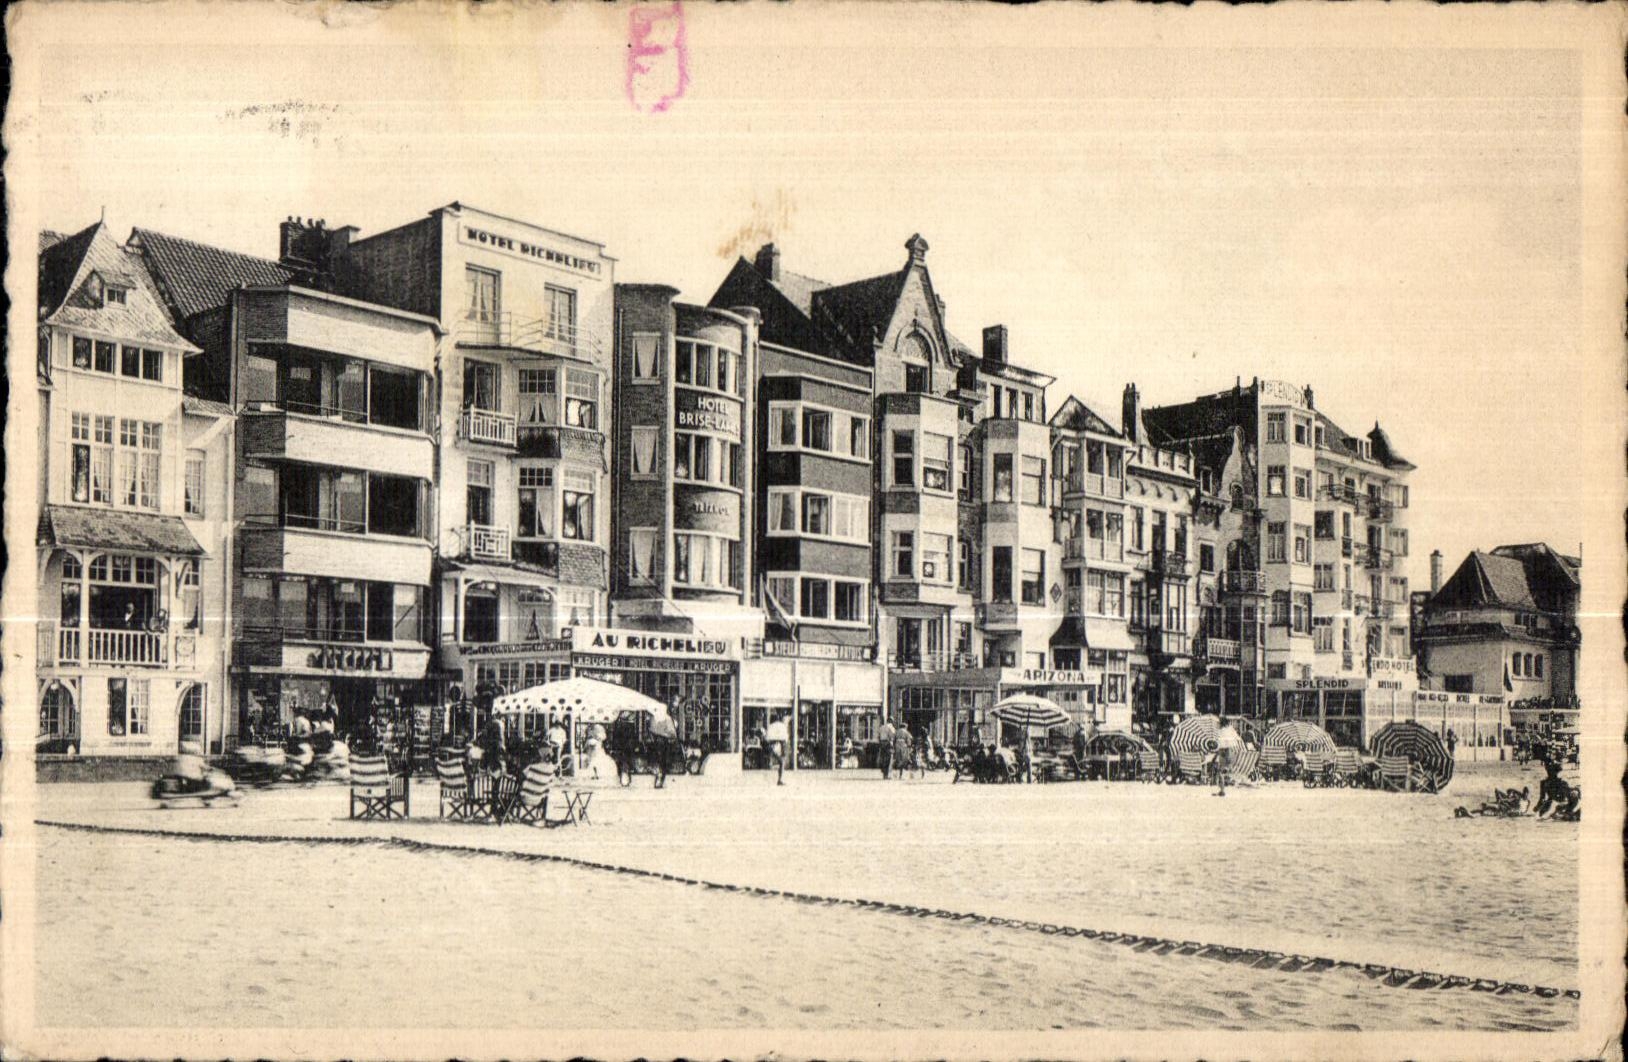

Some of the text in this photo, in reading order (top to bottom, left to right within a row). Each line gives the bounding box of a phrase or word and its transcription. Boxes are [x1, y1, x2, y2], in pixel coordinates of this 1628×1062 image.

[467, 229, 598, 273] HOTEL RICHELIEU
[697, 396, 728, 414] HOTEL
[592, 632, 618, 648] AU
[626, 636, 726, 654] RICHELIEU
[1023, 669, 1084, 683] ARIZONA
[1295, 679, 1349, 688] SPLENDID
